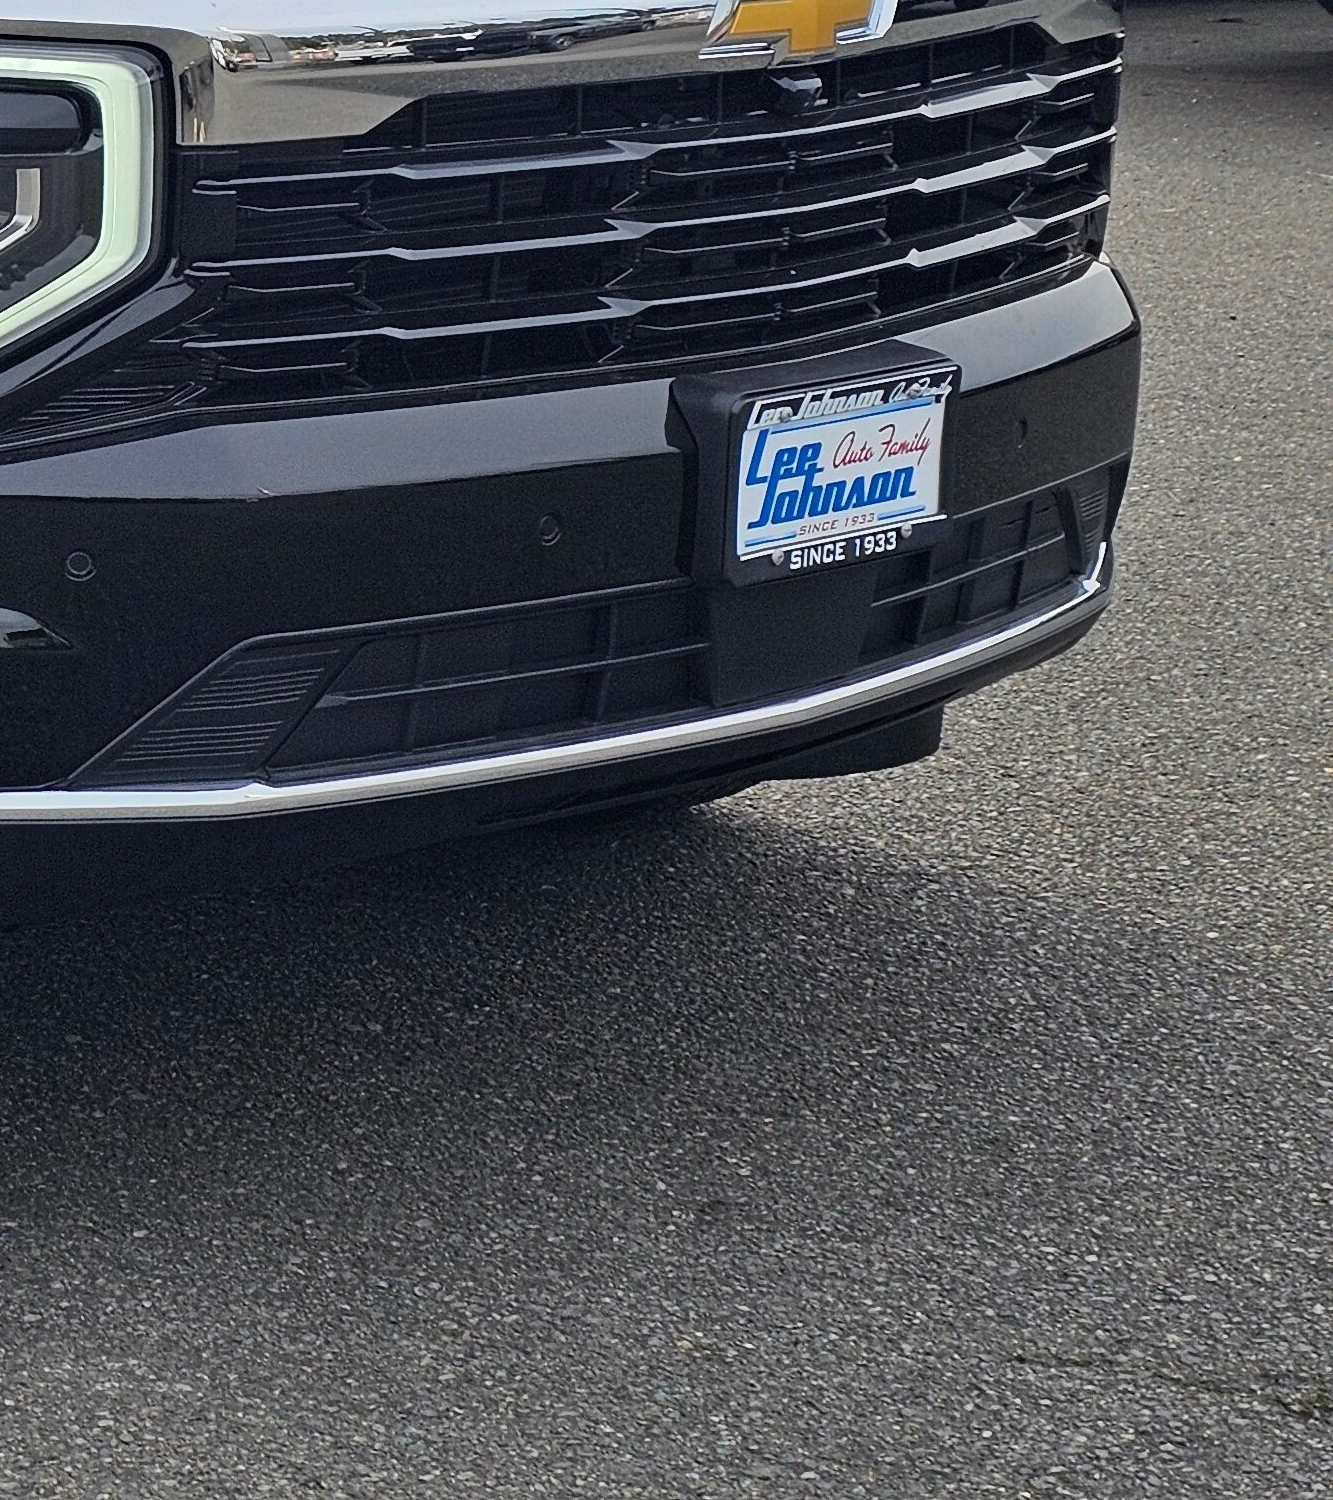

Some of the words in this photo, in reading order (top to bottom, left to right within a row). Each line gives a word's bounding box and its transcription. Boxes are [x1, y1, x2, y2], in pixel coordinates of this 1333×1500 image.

[789, 389, 884, 421] Johnson
[745, 428, 824, 487] Lee
[833, 431, 874, 469] Auto
[878, 417, 931, 466] Family
[747, 466, 917, 530] Johnson
[798, 521, 839, 537] SINCE
[844, 512, 876, 528] 1933
[789, 541, 847, 570] SINCE
[853, 531, 898, 557] 1933
